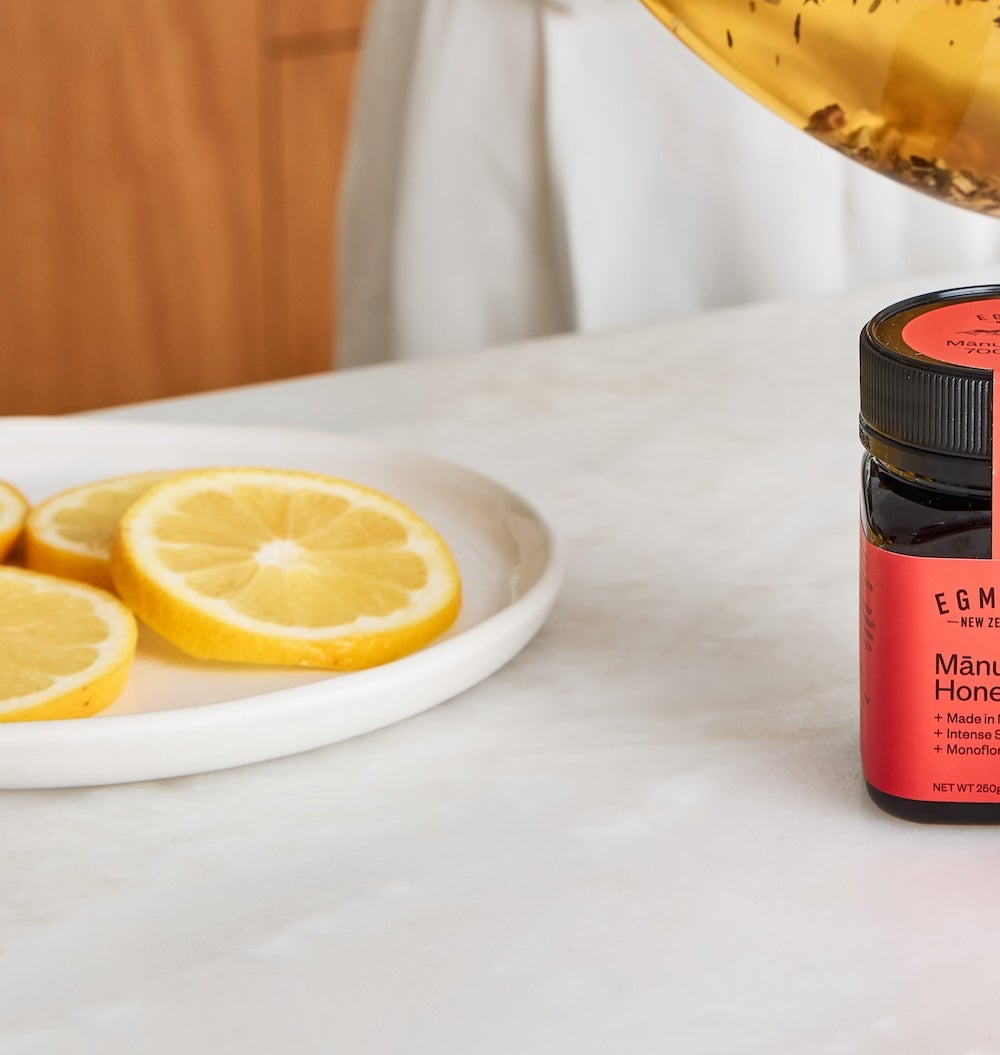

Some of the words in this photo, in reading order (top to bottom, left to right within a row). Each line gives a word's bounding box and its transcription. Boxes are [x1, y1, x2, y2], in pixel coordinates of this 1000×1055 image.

[961, 617, 984, 627] NEW
[947, 713, 981, 724] Made
[984, 713, 995, 724] in
[946, 728, 992, 740] Intense
[932, 782, 955, 792] NET
[956, 783, 974, 793] WT
